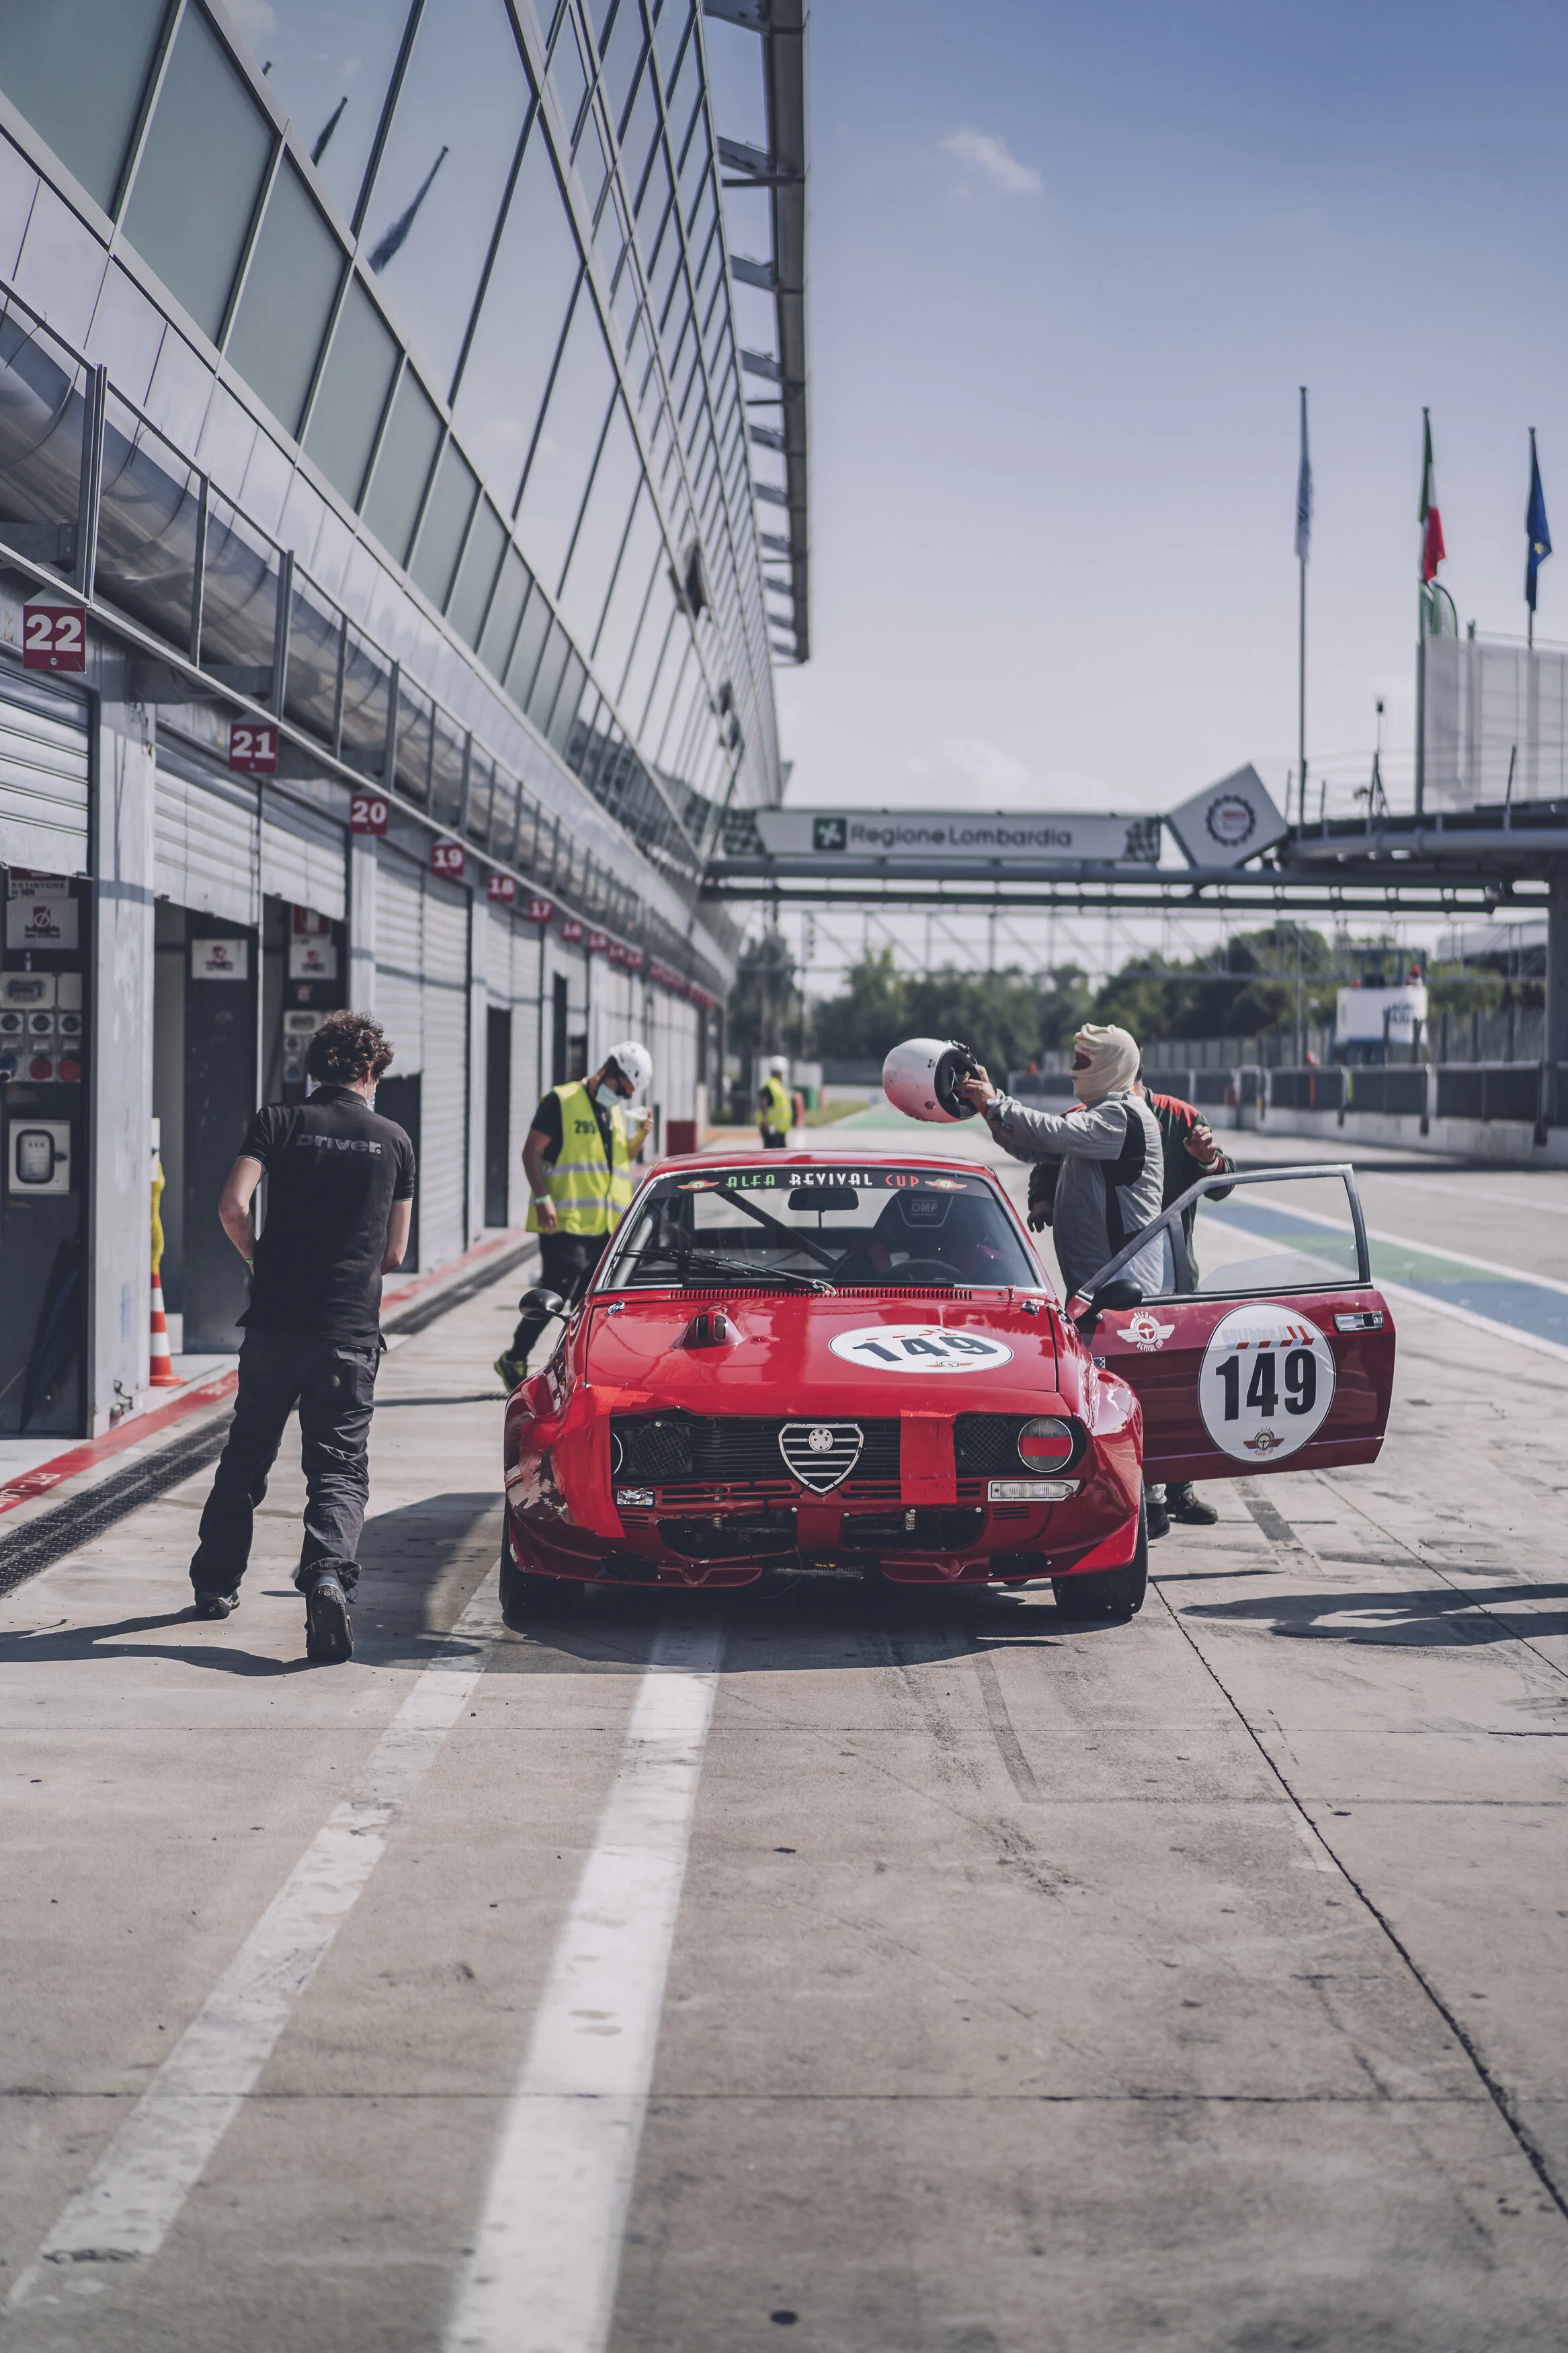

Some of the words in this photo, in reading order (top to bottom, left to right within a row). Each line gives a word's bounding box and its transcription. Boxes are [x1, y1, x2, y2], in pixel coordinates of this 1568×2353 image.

[26, 614, 81, 652] 22
[231, 730, 275, 759] 21
[351, 801, 386, 824] 20
[850, 824, 946, 848] Regione
[950, 825, 1072, 847] Lombardia
[434, 848, 463, 868] 19
[532, 902, 551, 917] 17
[726, 1174, 775, 1188] ALFA
[789, 1172, 873, 1186] REVIVAL
[885, 1174, 919, 1187] CUP
[911, 1202, 938, 1213] OMP
[852, 1336, 998, 1362] 149
[1216, 1349, 1317, 1421] 149
